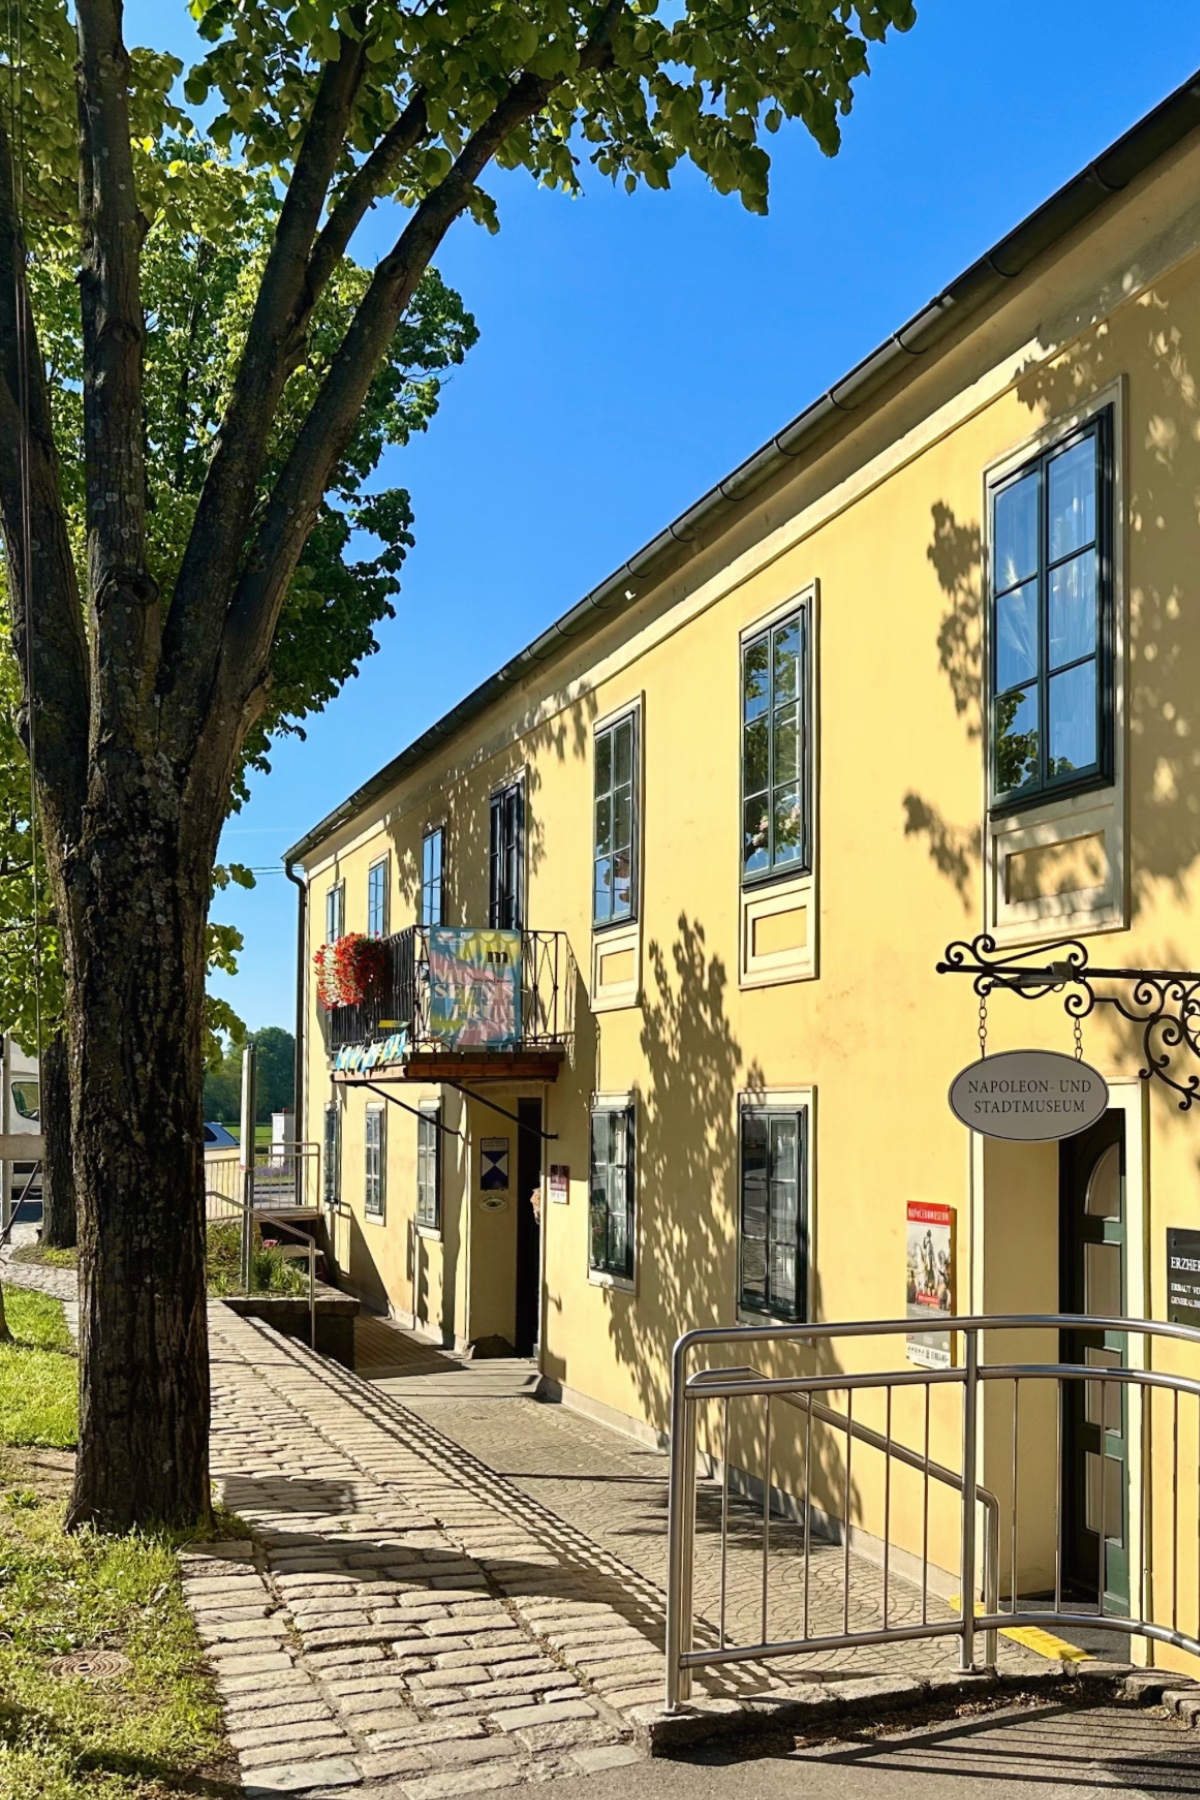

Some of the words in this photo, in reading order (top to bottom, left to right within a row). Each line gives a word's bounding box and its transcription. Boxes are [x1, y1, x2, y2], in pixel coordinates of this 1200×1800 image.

[968, 1080, 1055, 1093] NAPOLEON-
[1059, 1080, 1091, 1093] UND
[974, 1100, 1085, 1113] STADTMUSEUM
[1171, 1283, 1191, 1293] ERBAUT
